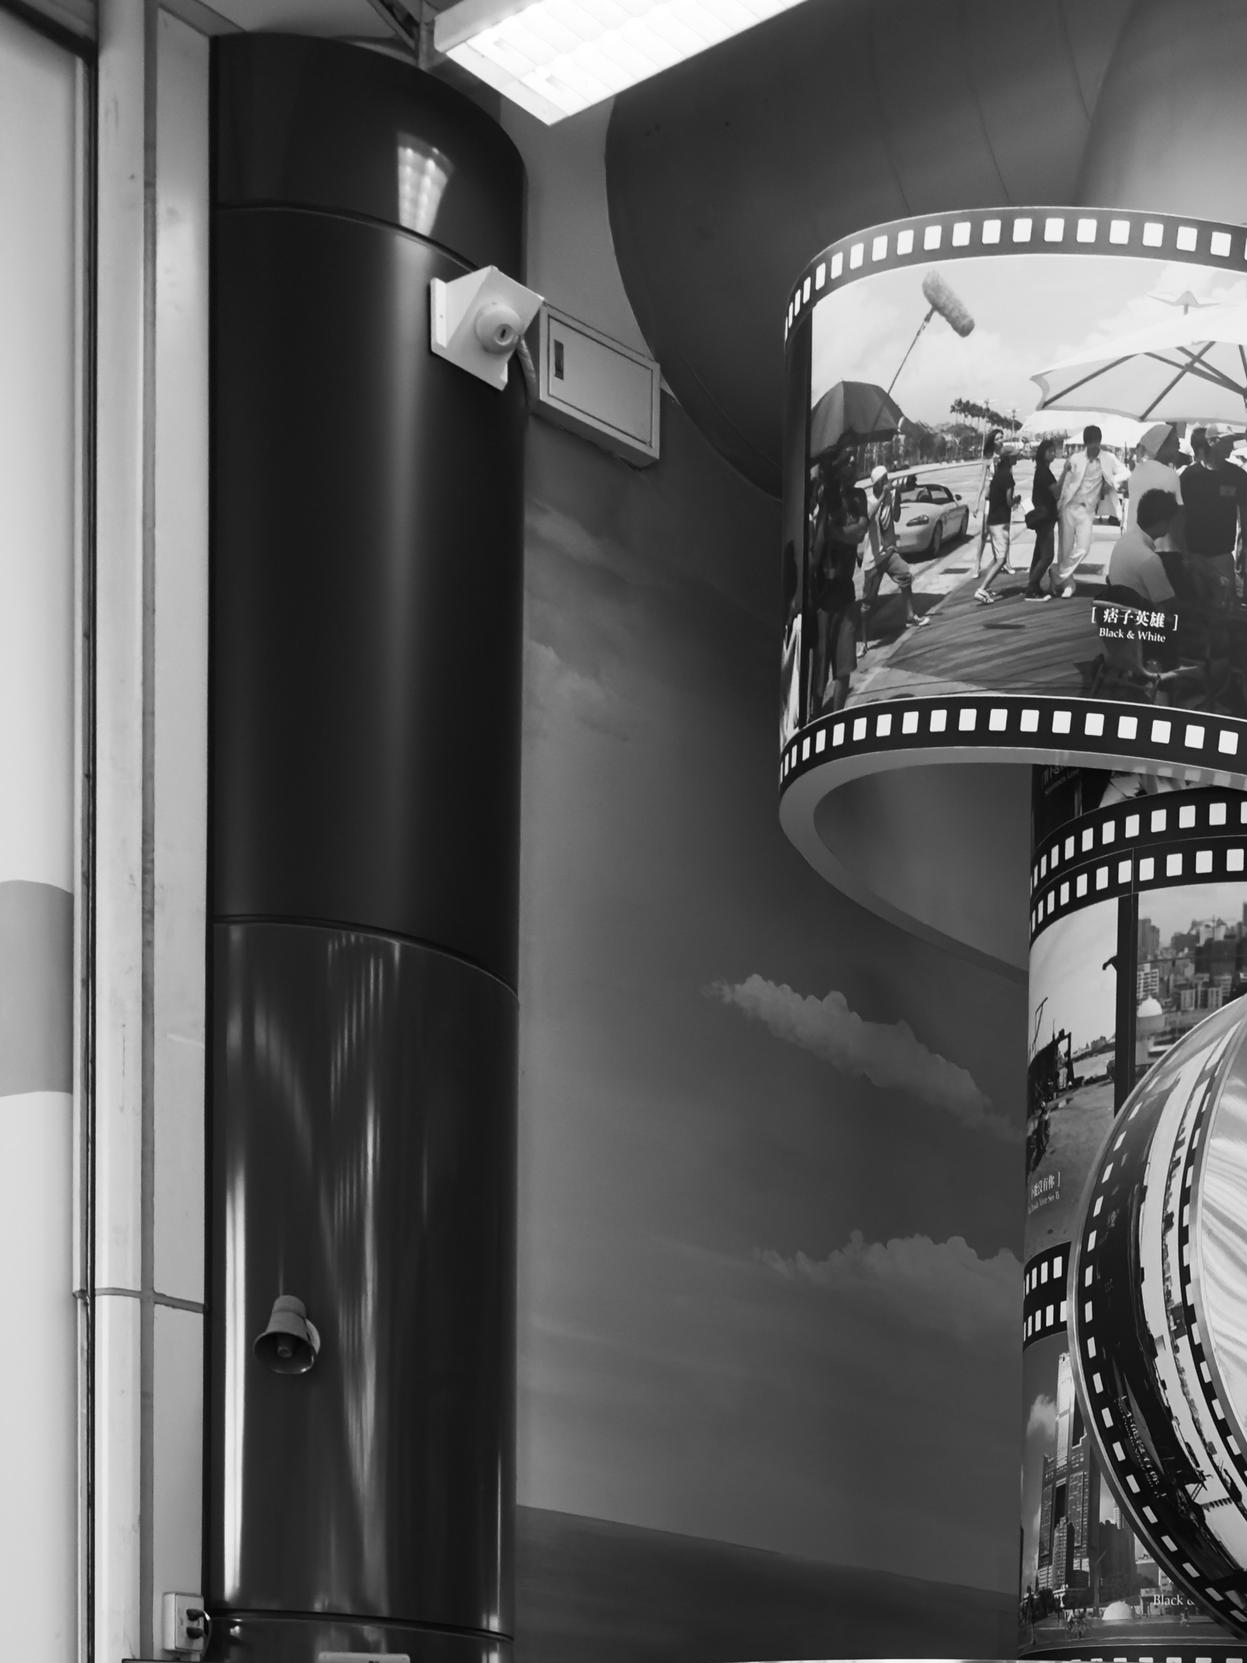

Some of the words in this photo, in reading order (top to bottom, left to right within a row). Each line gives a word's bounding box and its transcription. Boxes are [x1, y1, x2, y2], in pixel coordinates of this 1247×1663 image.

[1099, 627, 1124, 639] Black
[1126, 630, 1135, 640] &
[1138, 630, 1166, 643] White
[1153, 1594, 1183, 1606] Black
